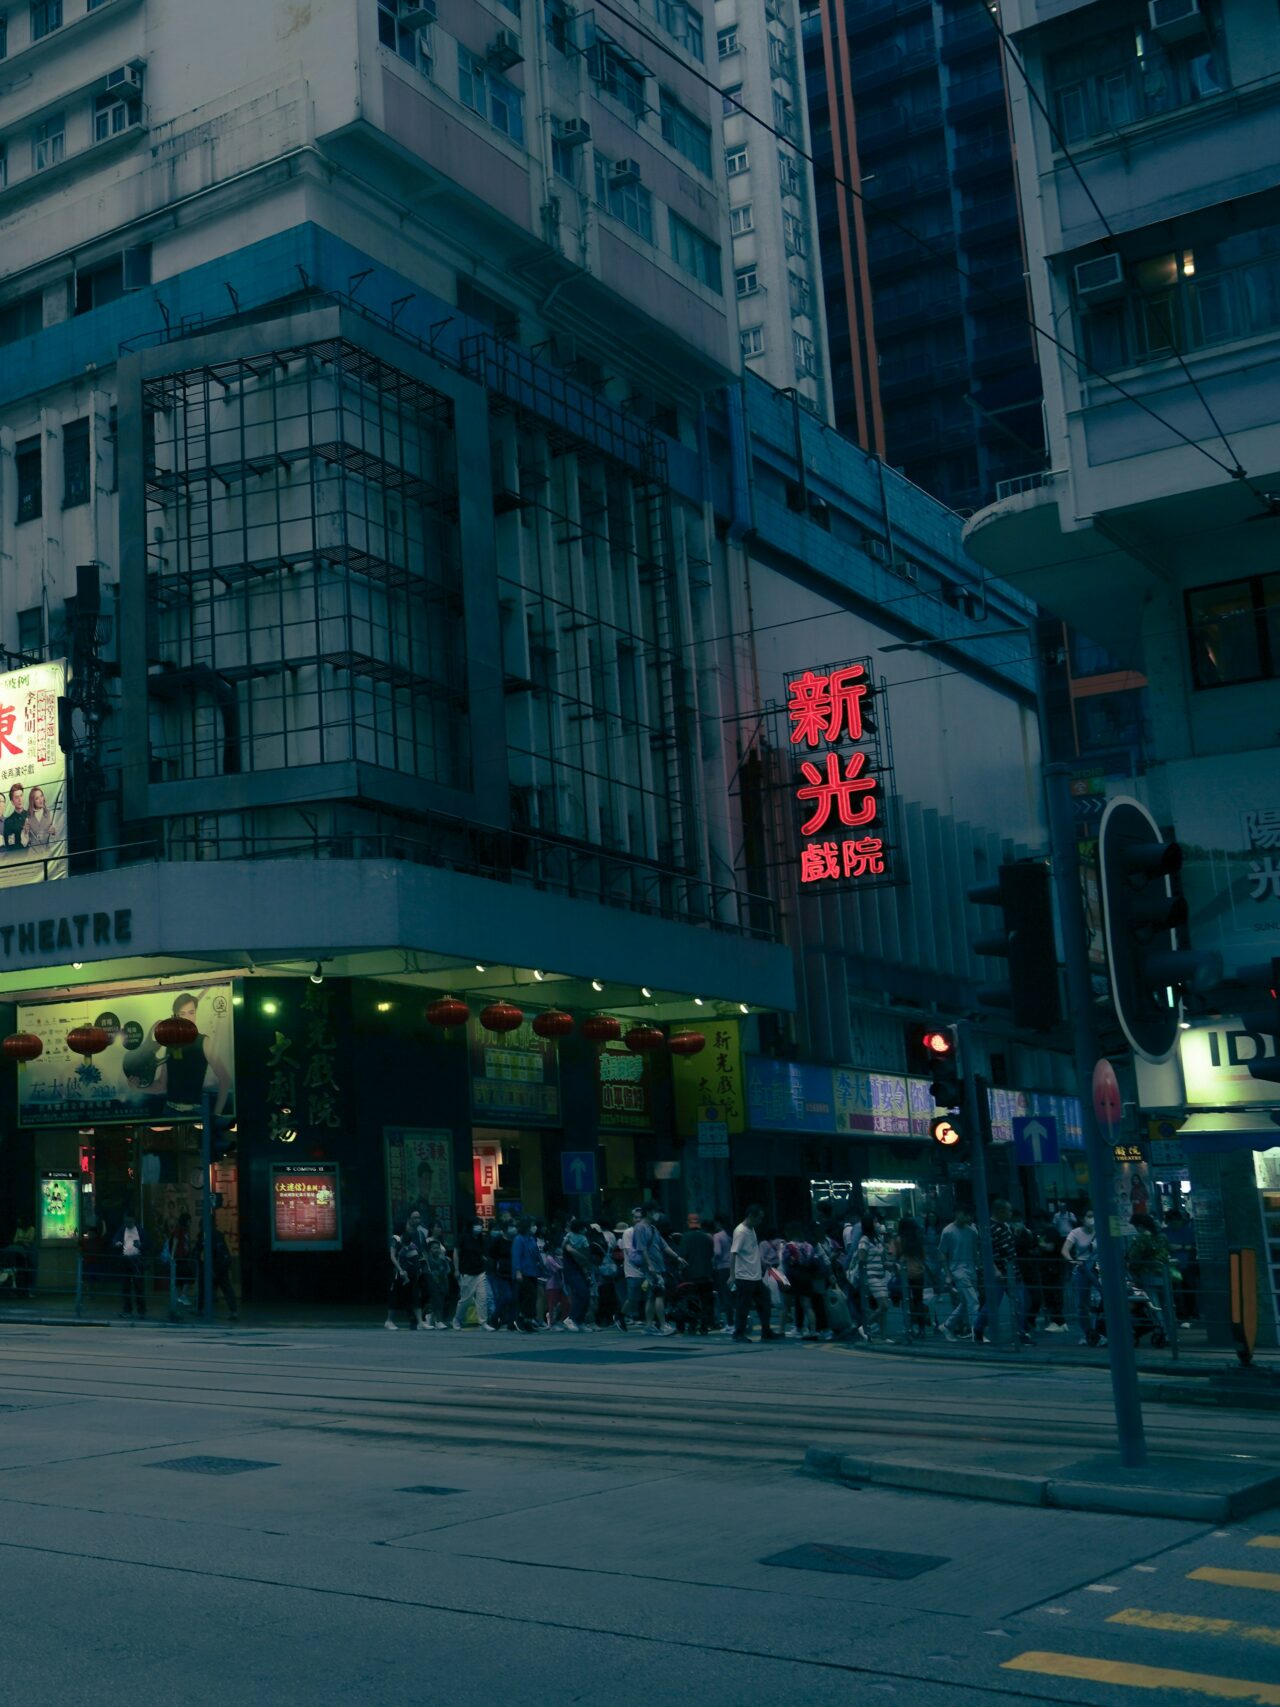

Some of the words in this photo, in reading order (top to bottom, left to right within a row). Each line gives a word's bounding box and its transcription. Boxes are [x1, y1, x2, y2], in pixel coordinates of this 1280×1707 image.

[788, 665, 877, 836] 新光
[801, 837, 885, 883] 戲院
[0, 908, 133, 958] THEATRE
